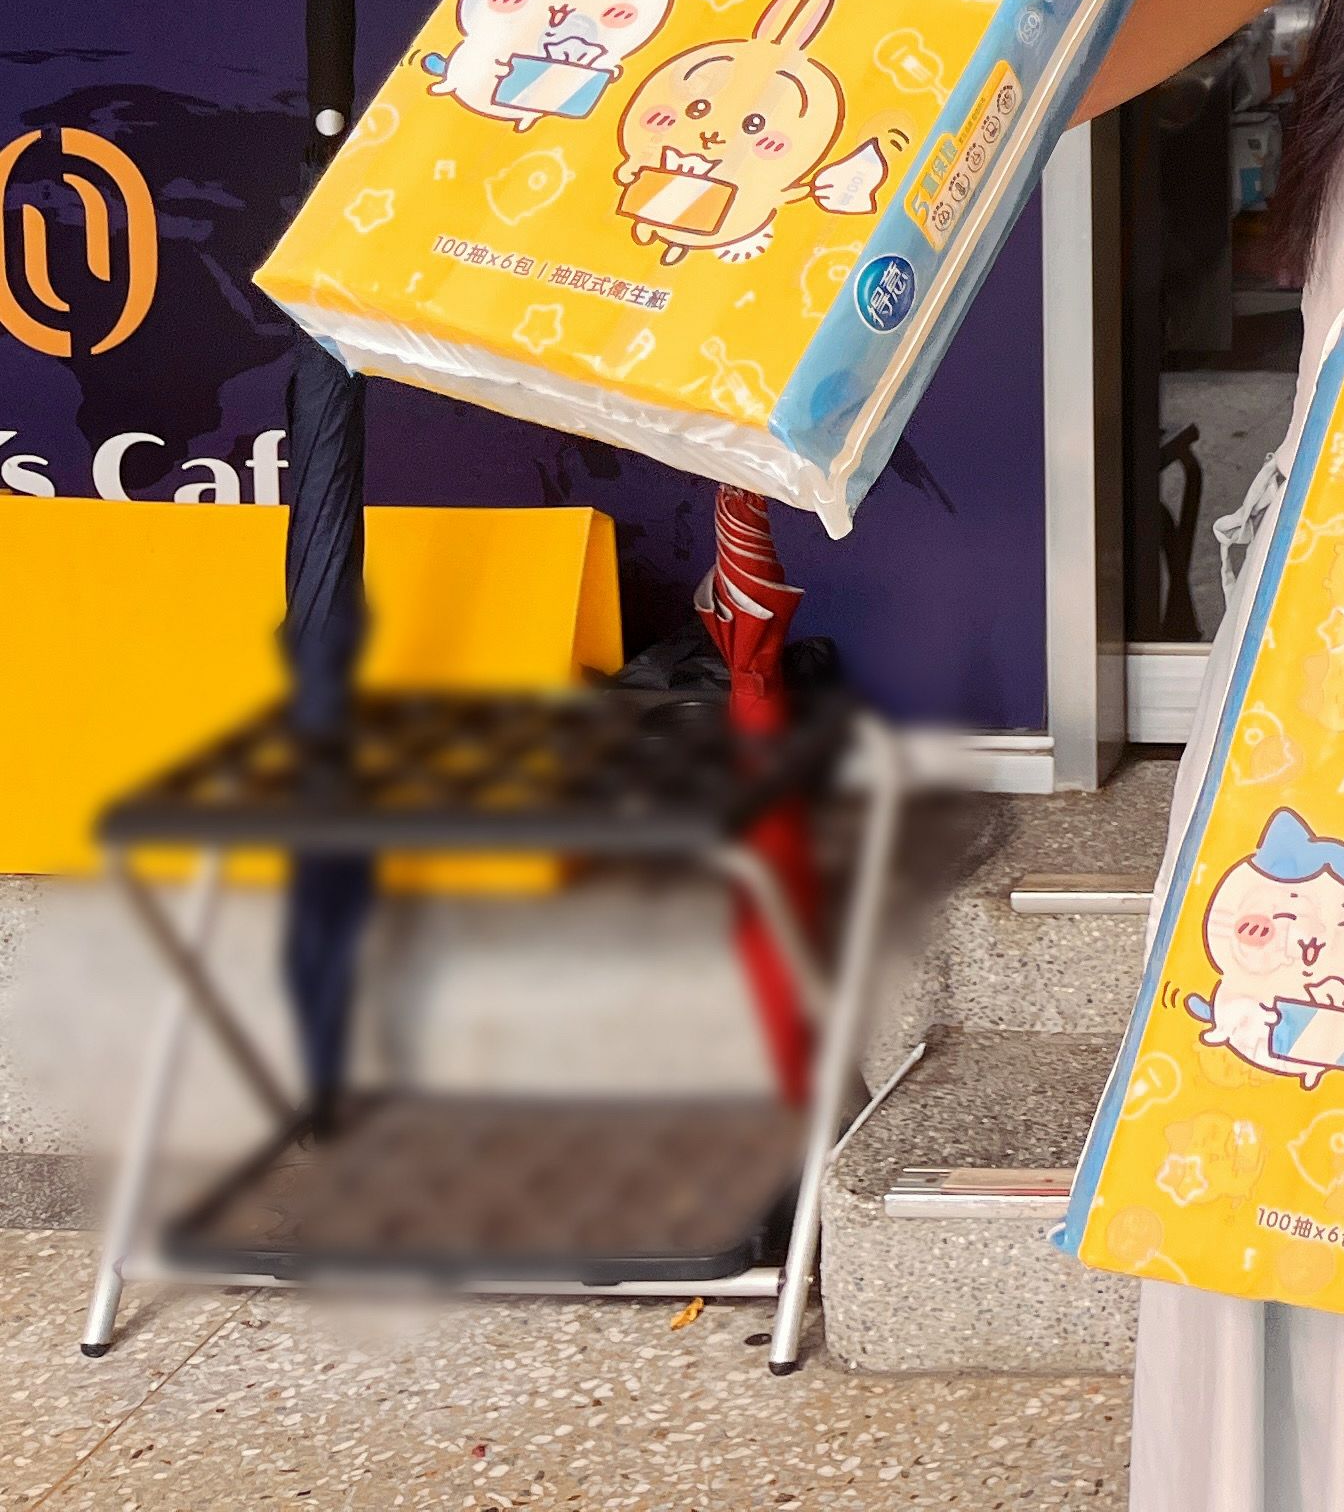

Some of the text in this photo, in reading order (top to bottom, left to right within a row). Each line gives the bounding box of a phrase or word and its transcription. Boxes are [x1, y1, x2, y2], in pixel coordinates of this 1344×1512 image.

[548, 264, 671, 312] 抽取式衛生紙
